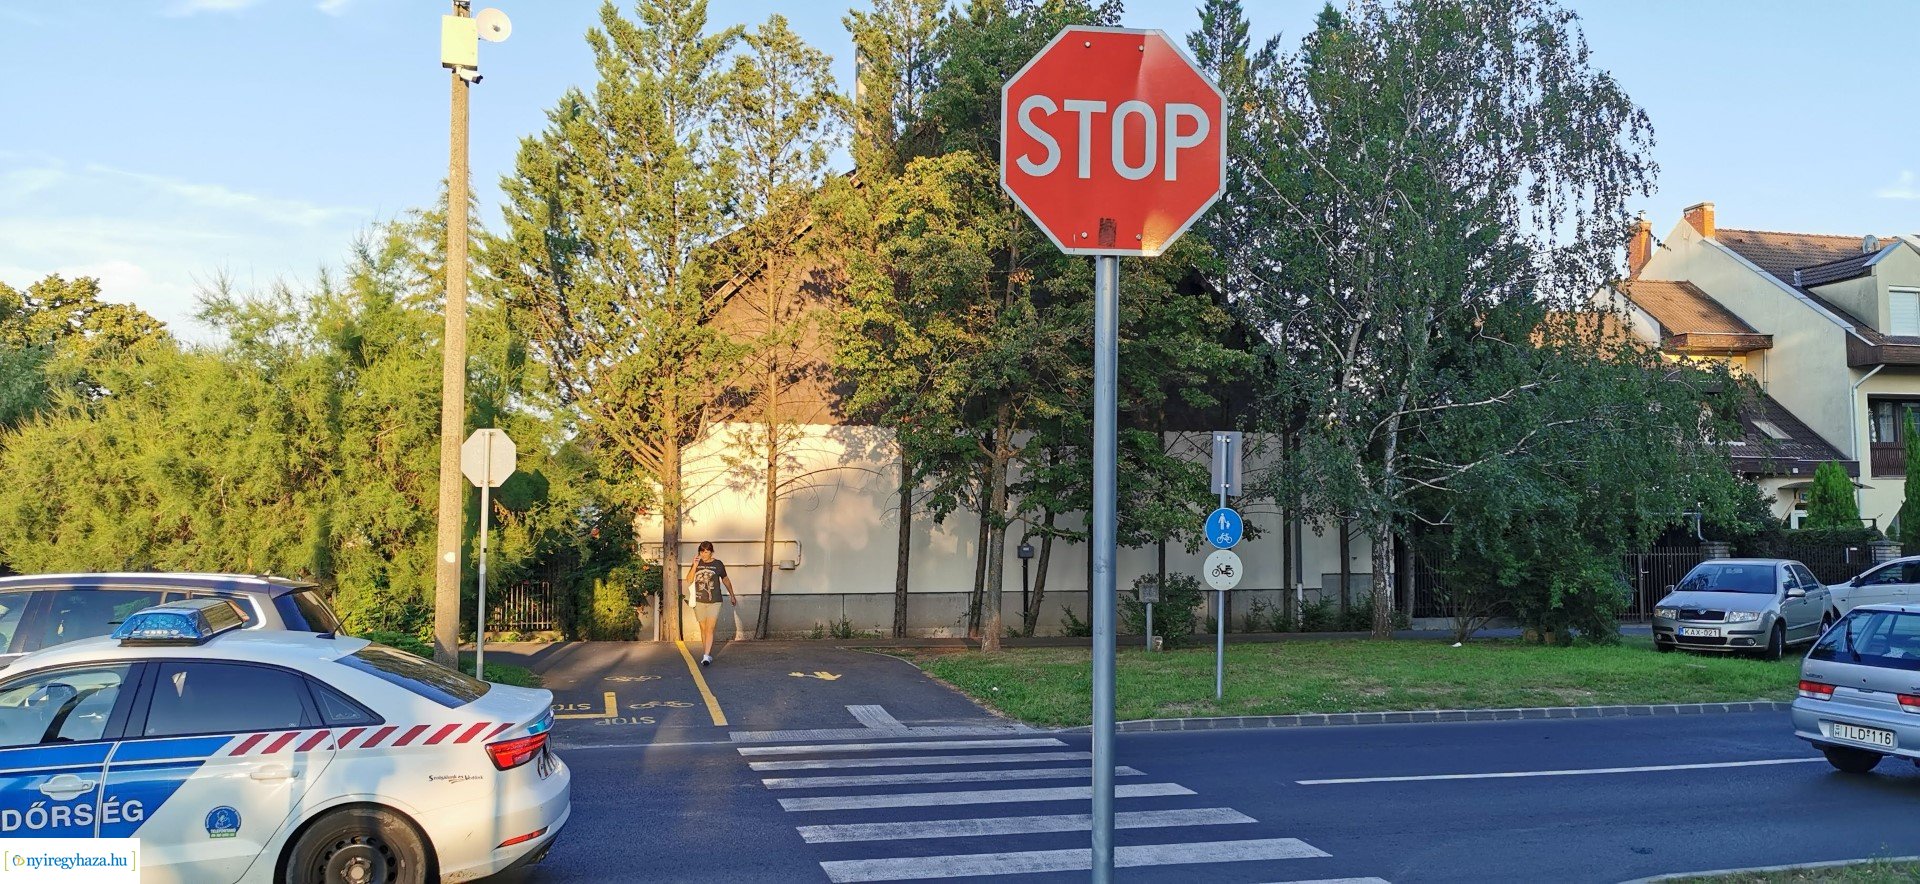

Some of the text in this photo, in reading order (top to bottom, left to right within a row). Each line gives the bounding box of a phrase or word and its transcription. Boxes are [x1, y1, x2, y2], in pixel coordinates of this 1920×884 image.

[1015, 94, 1211, 182] STOP
[594, 716, 656, 725] STOP
[1, 796, 143, 832] DŐRSÉG
